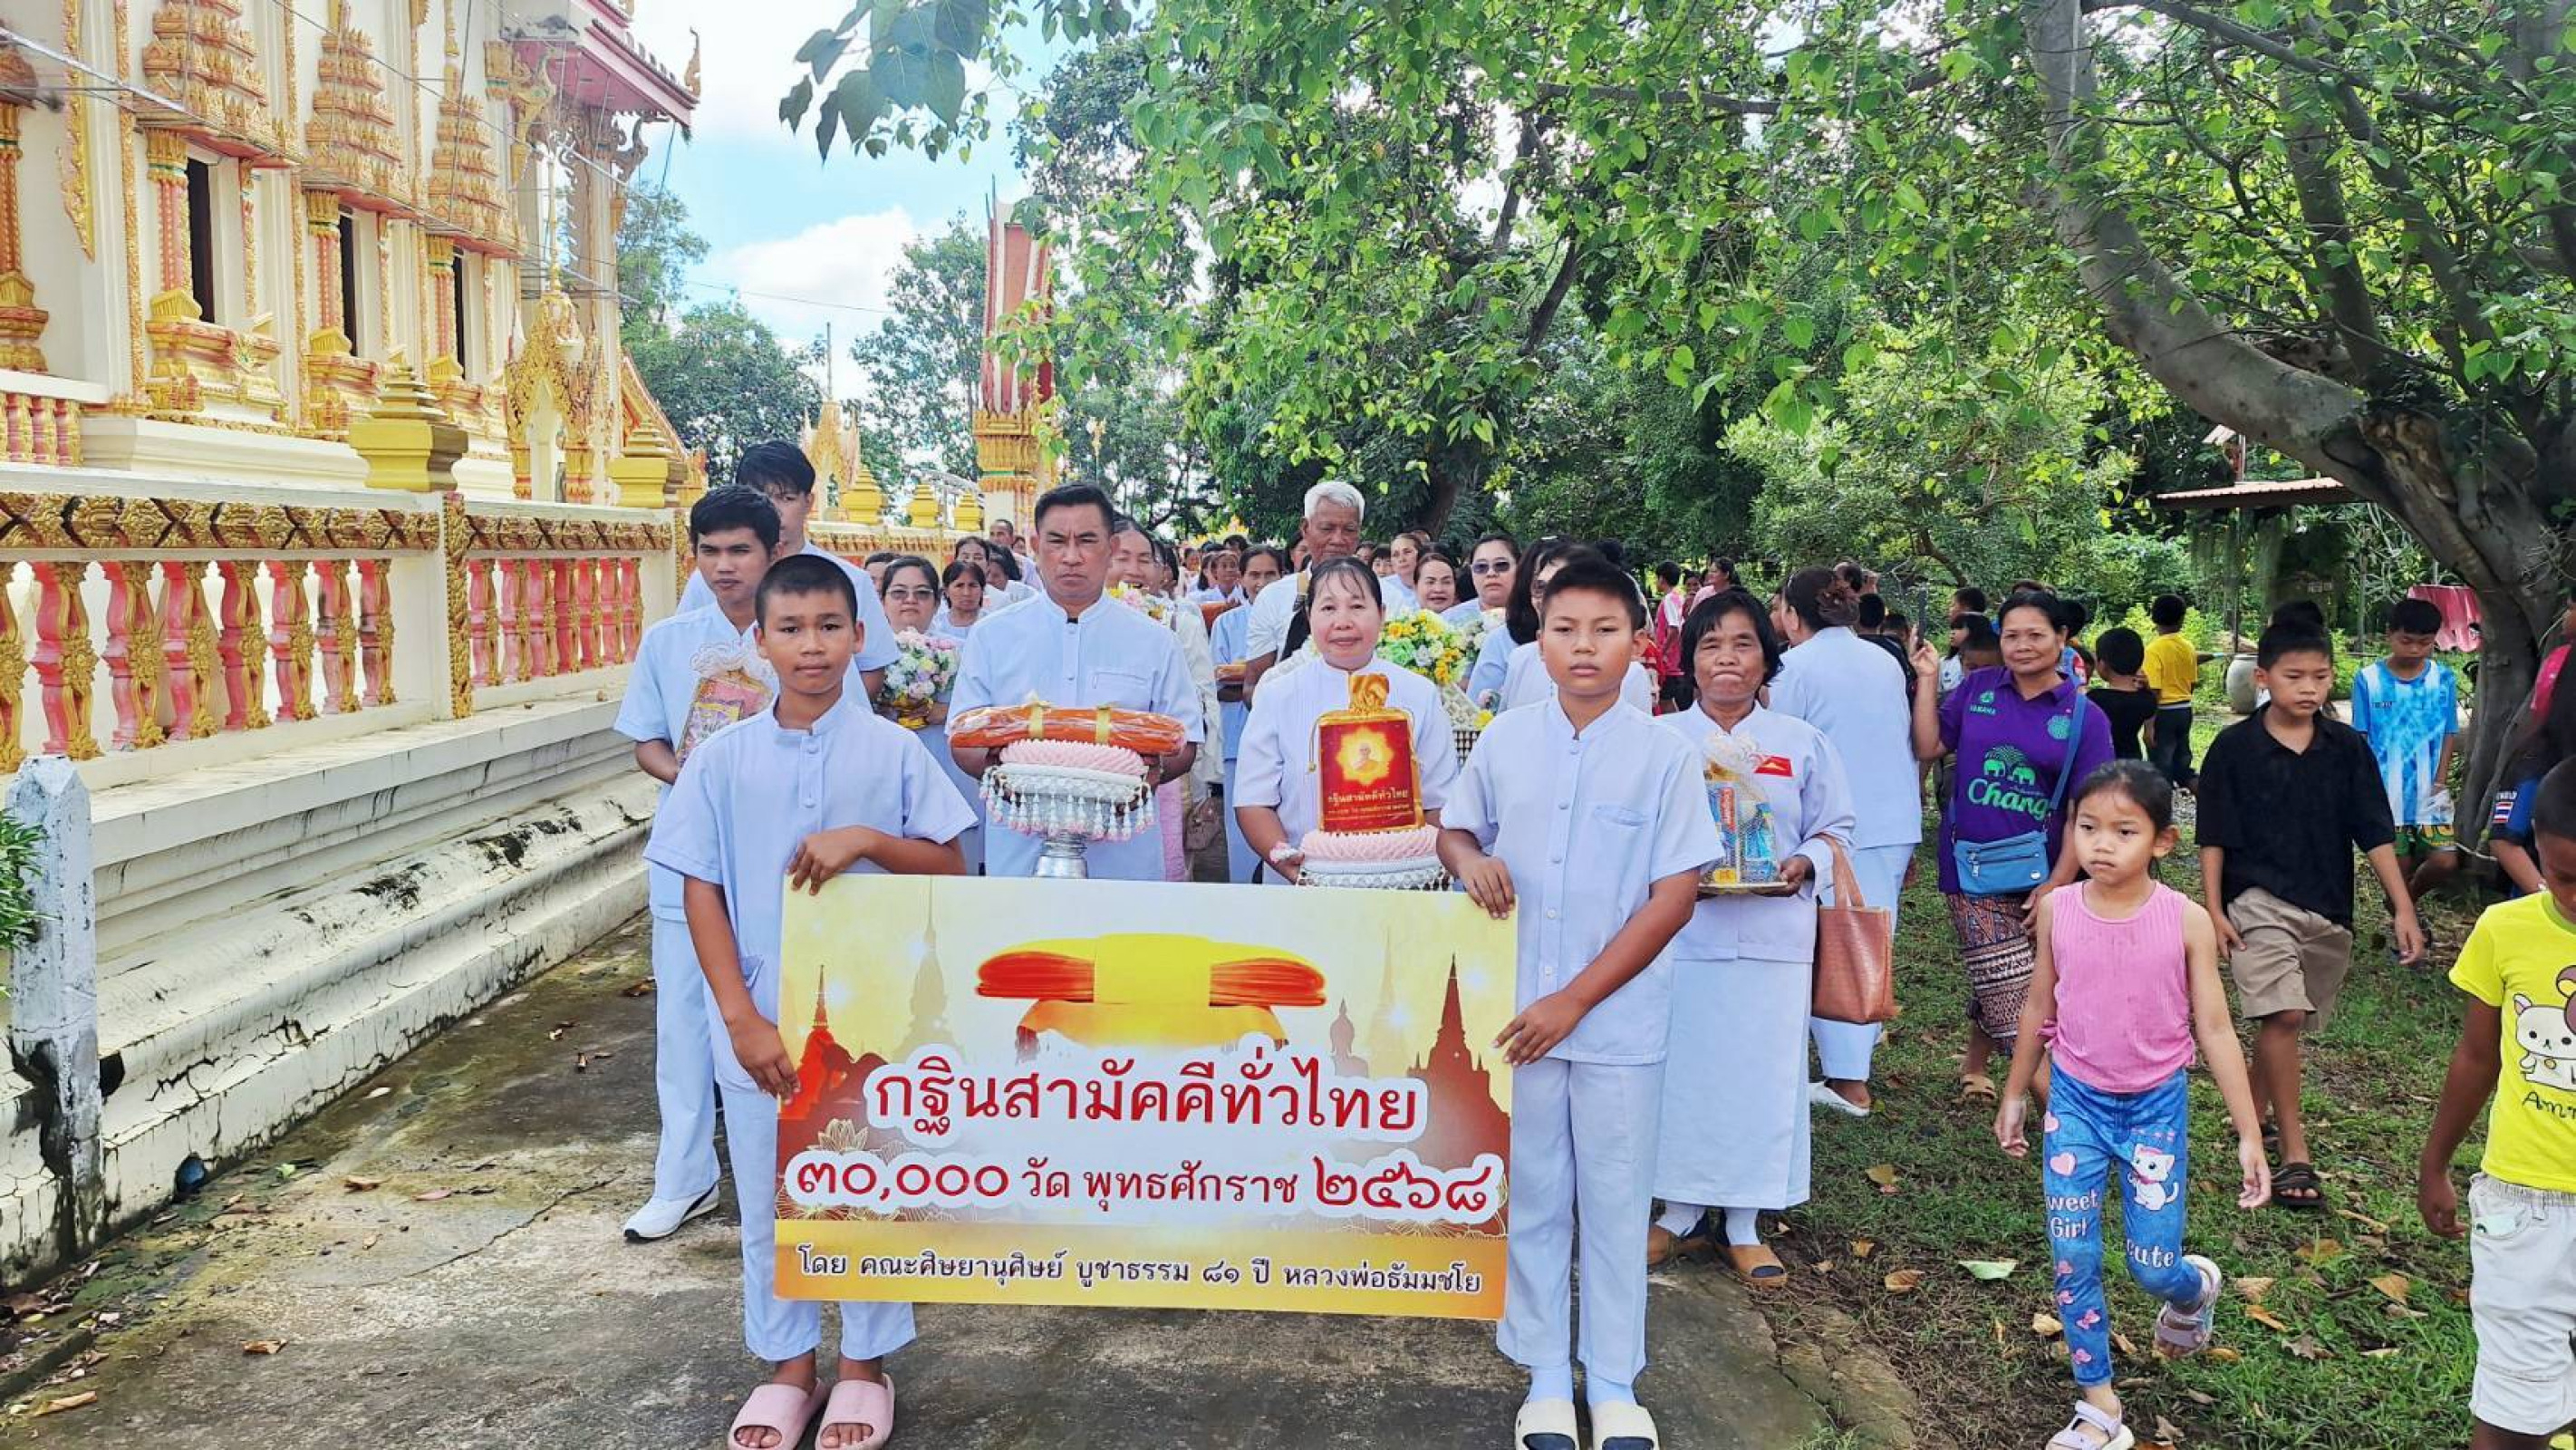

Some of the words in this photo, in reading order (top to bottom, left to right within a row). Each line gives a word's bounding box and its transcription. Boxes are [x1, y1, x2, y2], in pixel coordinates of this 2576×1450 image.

[1968, 778, 2050, 821] Chang
[875, 1046, 1416, 1136] กฐินสามัคคีทั่วไทย
[796, 1161, 1009, 1201] ๓๐,๐๐๐
[1021, 1156, 1070, 1198] วัด
[1083, 1159, 1298, 1213] พุทธศักราช
[1313, 1155, 1492, 1213] ๒๕๖๘
[2046, 1188, 2099, 1213] weet
[2050, 1216, 2087, 1239] Girl
[797, 1245, 847, 1275] โดย
[860, 1249, 1066, 1286] คณะศิษยานุศิษย์
[1076, 1258, 1189, 1288] บูชาธรรม
[1202, 1260, 1240, 1283] ๘๑
[1251, 1257, 1269, 1284] ปี
[1284, 1261, 1481, 1293] หลวงพ่อธัมมชโย
